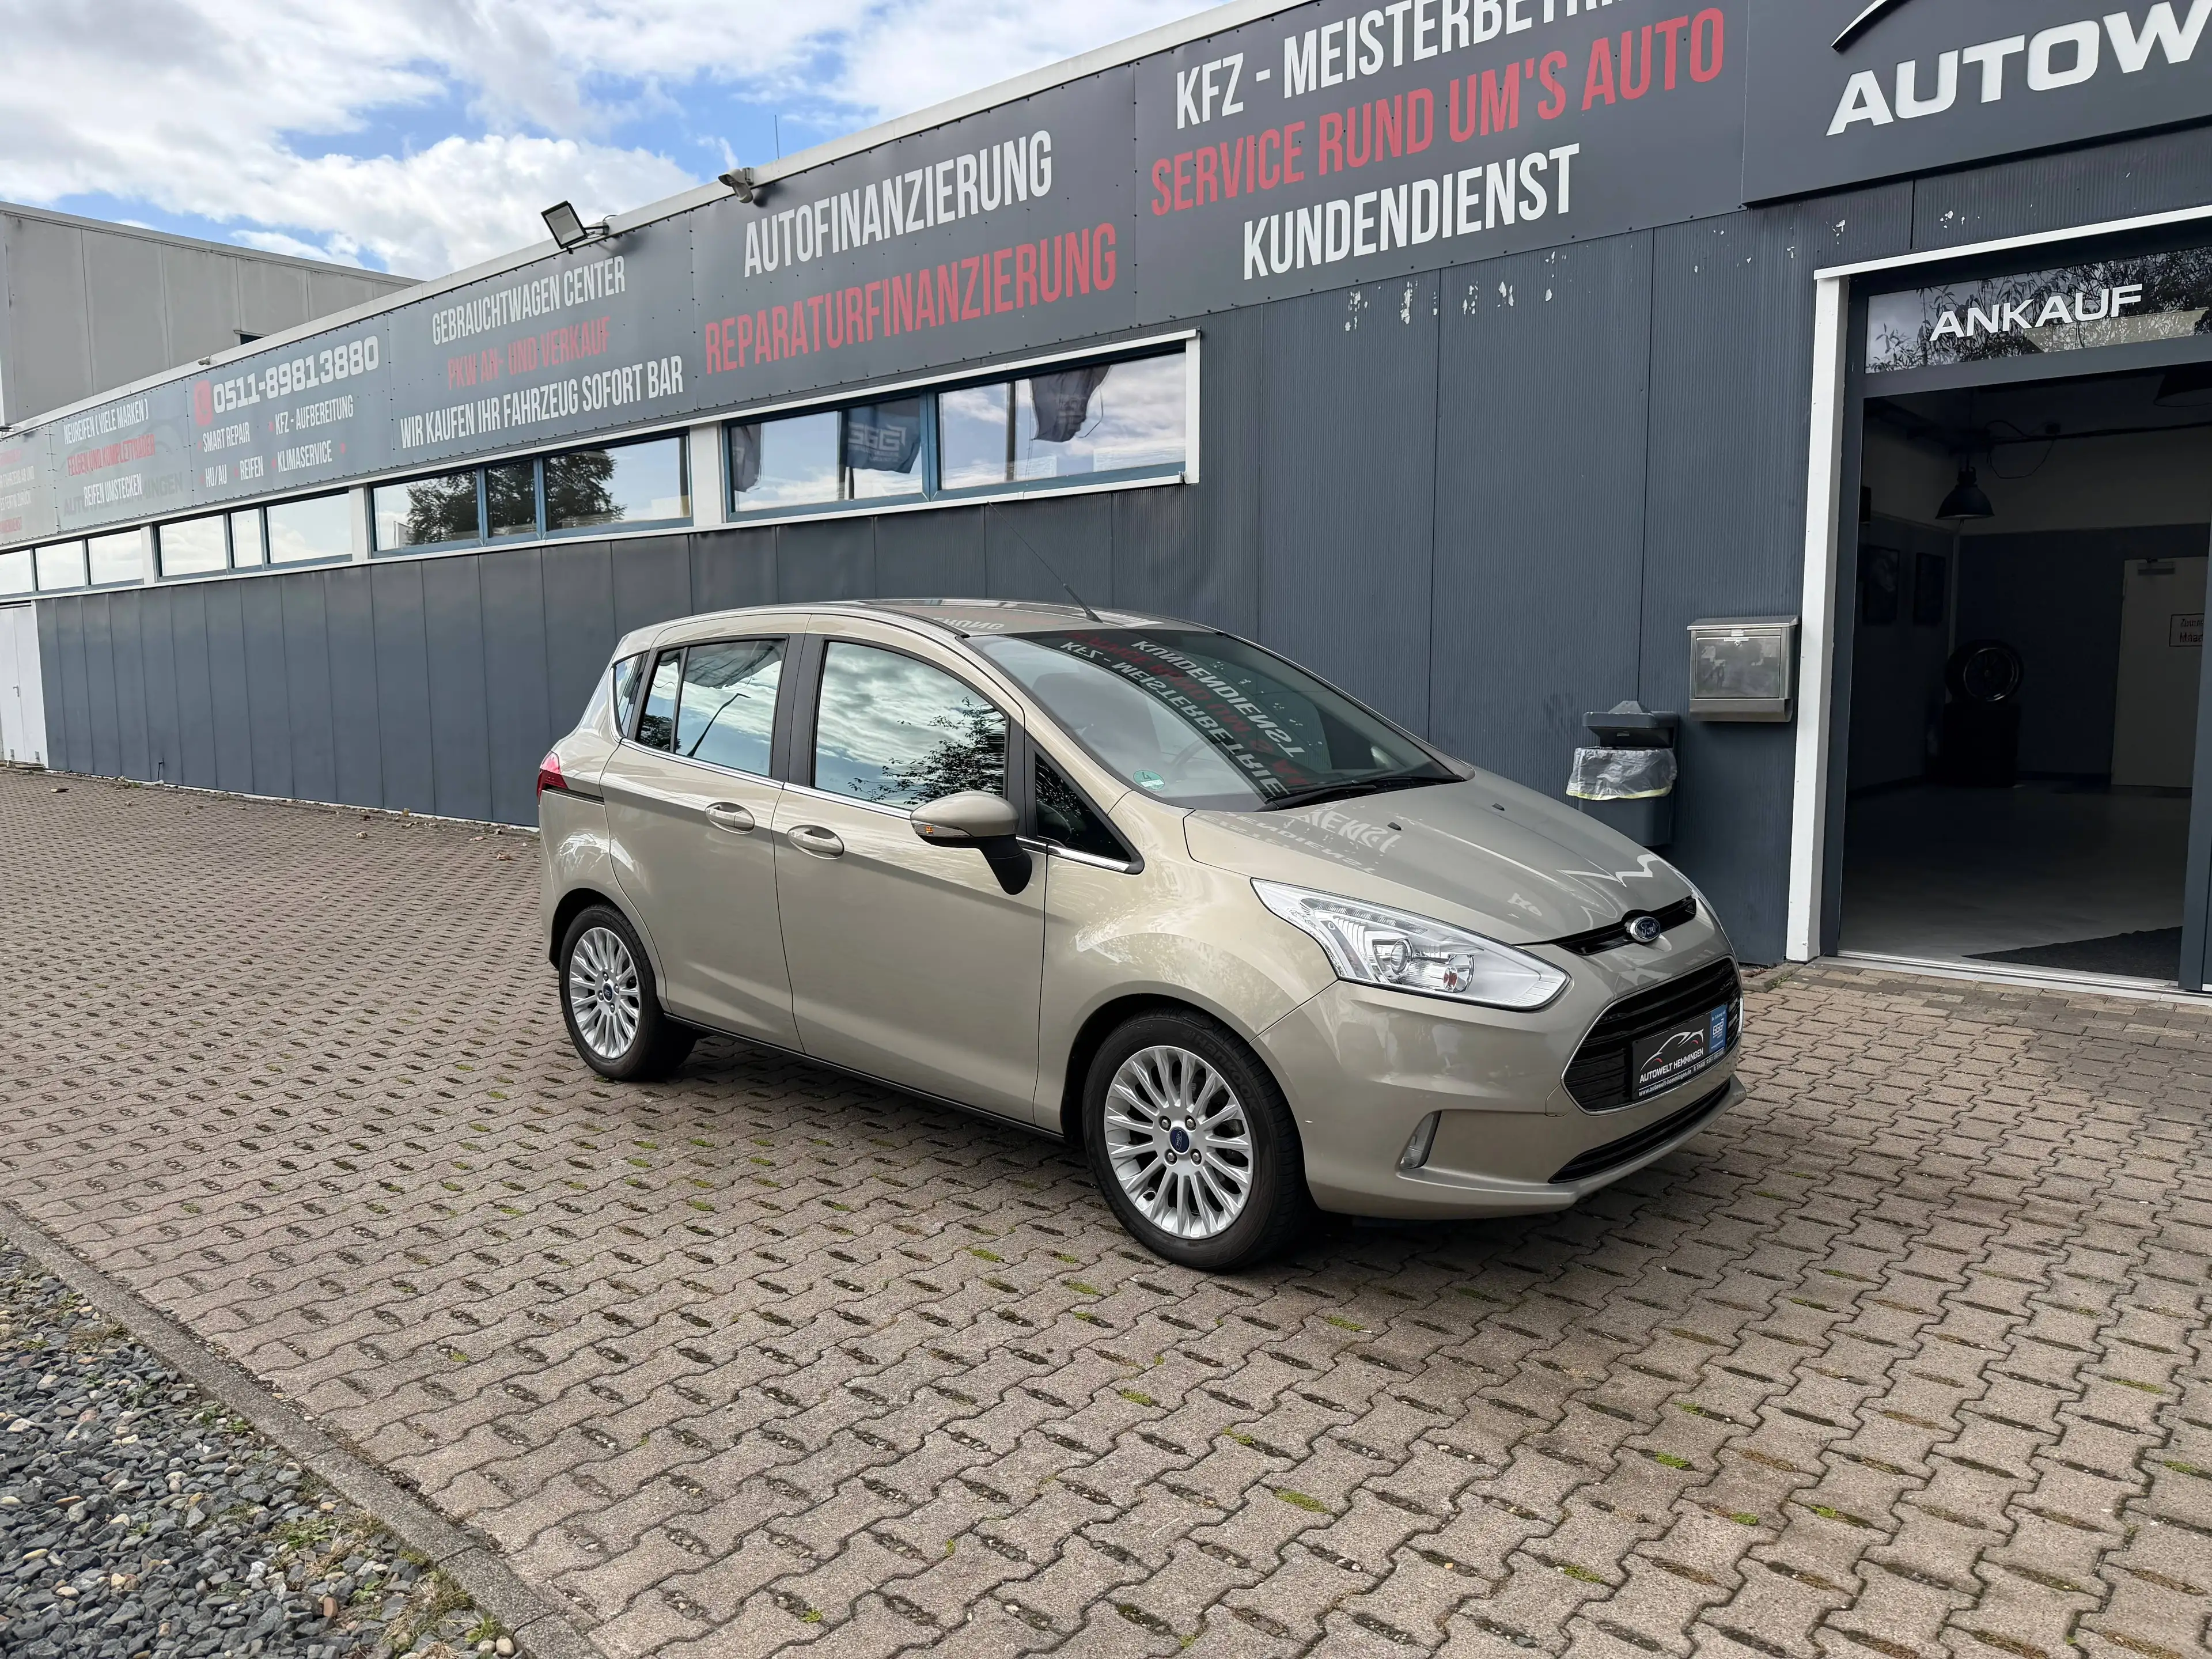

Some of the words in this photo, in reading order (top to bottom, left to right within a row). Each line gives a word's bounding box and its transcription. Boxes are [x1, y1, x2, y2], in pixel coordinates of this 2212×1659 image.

[1152, 120, 1305, 216] SERVICE
[1318, 88, 1434, 176] RUND
[1448, 50, 1567, 143] UM'S
[1581, 7, 1725, 111] AUTO
[1175, 52, 1244, 130] KFZ
[744, 130, 1052, 278] AUTOFINANZIERUNG
[1244, 143, 1580, 281] KUNDENDIENST
[432, 274, 560, 345] GEBRAUCHTWAGEN
[563, 255, 626, 306] CENTER
[705, 222, 1117, 374] REPARATURFINANZIERUNG
[1929, 283, 2142, 342] ANKAUF
[213, 335, 380, 414] 0511-89813880
[448, 354, 476, 390] PKW
[480, 348, 504, 381] AN-
[507, 336, 537, 376] UND
[540, 316, 610, 368] VERKAUF
[63, 416, 95, 445] NEUREIFEN
[100, 409, 117, 434] VIELE
[117, 400, 144, 429] MARKEN
[275, 411, 289, 435] KFZ
[296, 395, 354, 430] AUFBEREITUNG
[400, 414, 423, 448] WIR
[426, 403, 475, 444] KAUFEN
[478, 396, 501, 432] IHR
[503, 378, 579, 428] FAHRZEUG
[581, 363, 642, 411] SOFORT
[647, 355, 683, 399] BAR
[202, 430, 225, 453] SMART
[225, 422, 250, 448] REPAIR
[277, 440, 332, 472] KLIMASERVICE
[84, 483, 105, 506] REIFEN
[105, 474, 143, 502] UMSTECKEN
[205, 464, 228, 487] HU/AU
[239, 456, 263, 480] REIFEN
[1641, 920, 1658, 937] Ford
[1639, 1064, 1672, 1084] AUTOWELT
[1673, 1047, 1703, 1070] HEMMINGEN
